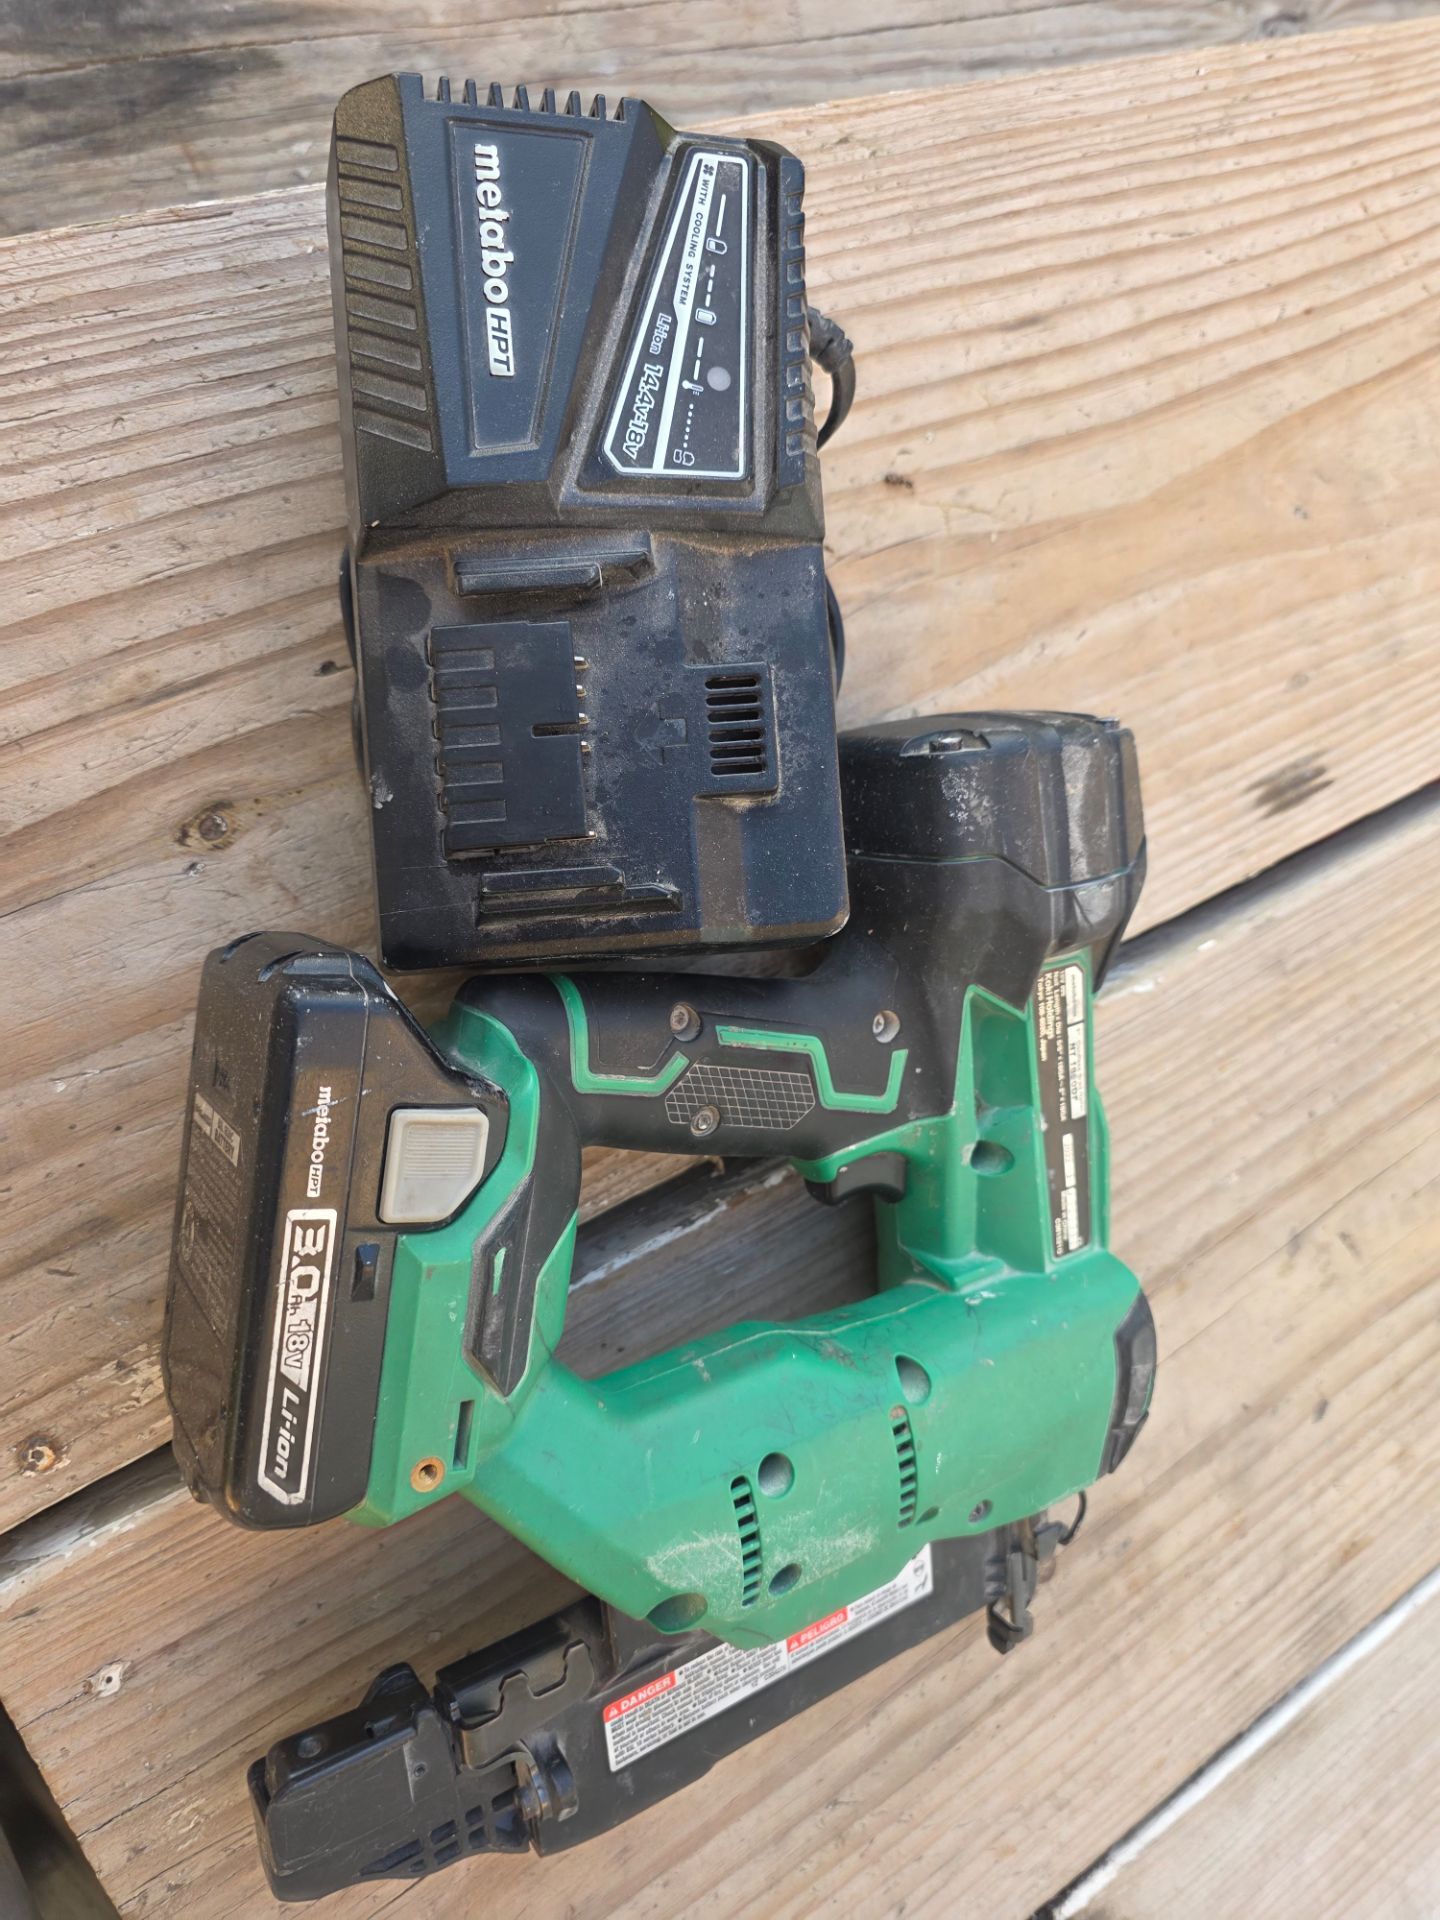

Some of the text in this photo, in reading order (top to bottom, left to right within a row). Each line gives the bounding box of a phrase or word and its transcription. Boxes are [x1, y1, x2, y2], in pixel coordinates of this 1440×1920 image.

[474, 143, 515, 374] metabo HPT
[678, 178, 710, 306] WITH COOLING SYSTEM
[648, 312, 672, 355] Li-ion
[308, 1086, 332, 1195] metabo HPT
[274, 1387, 300, 1479] Li-ion
[799, 1612, 846, 1643] PELIGRO
[620, 1677, 673, 1711] DANGER
